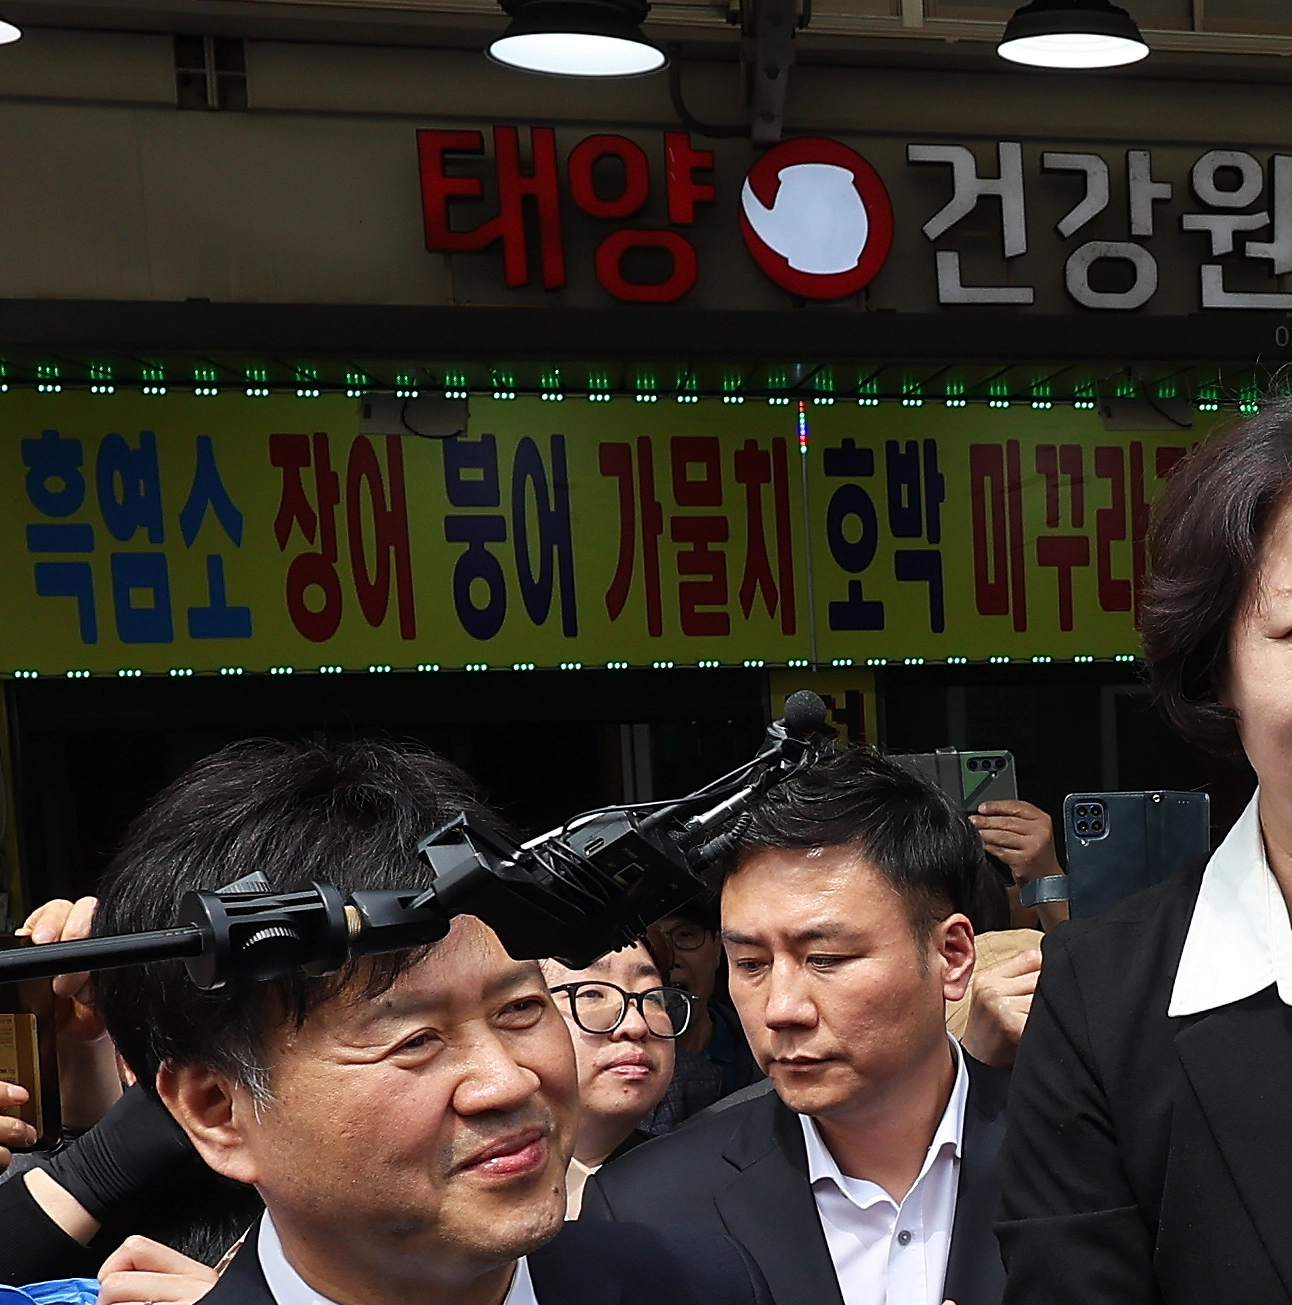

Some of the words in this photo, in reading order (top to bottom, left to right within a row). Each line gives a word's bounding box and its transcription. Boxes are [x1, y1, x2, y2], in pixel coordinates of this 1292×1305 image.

[416, 126, 716, 303] 태양
[21, 430, 252, 645] 흑염소
[269, 433, 416, 643] 장어
[442, 434, 578, 641] 붕어
[599, 436, 796, 638] 가물치
[824, 438, 946, 633] 호박
[970, 439, 1192, 633] 미꾸라
